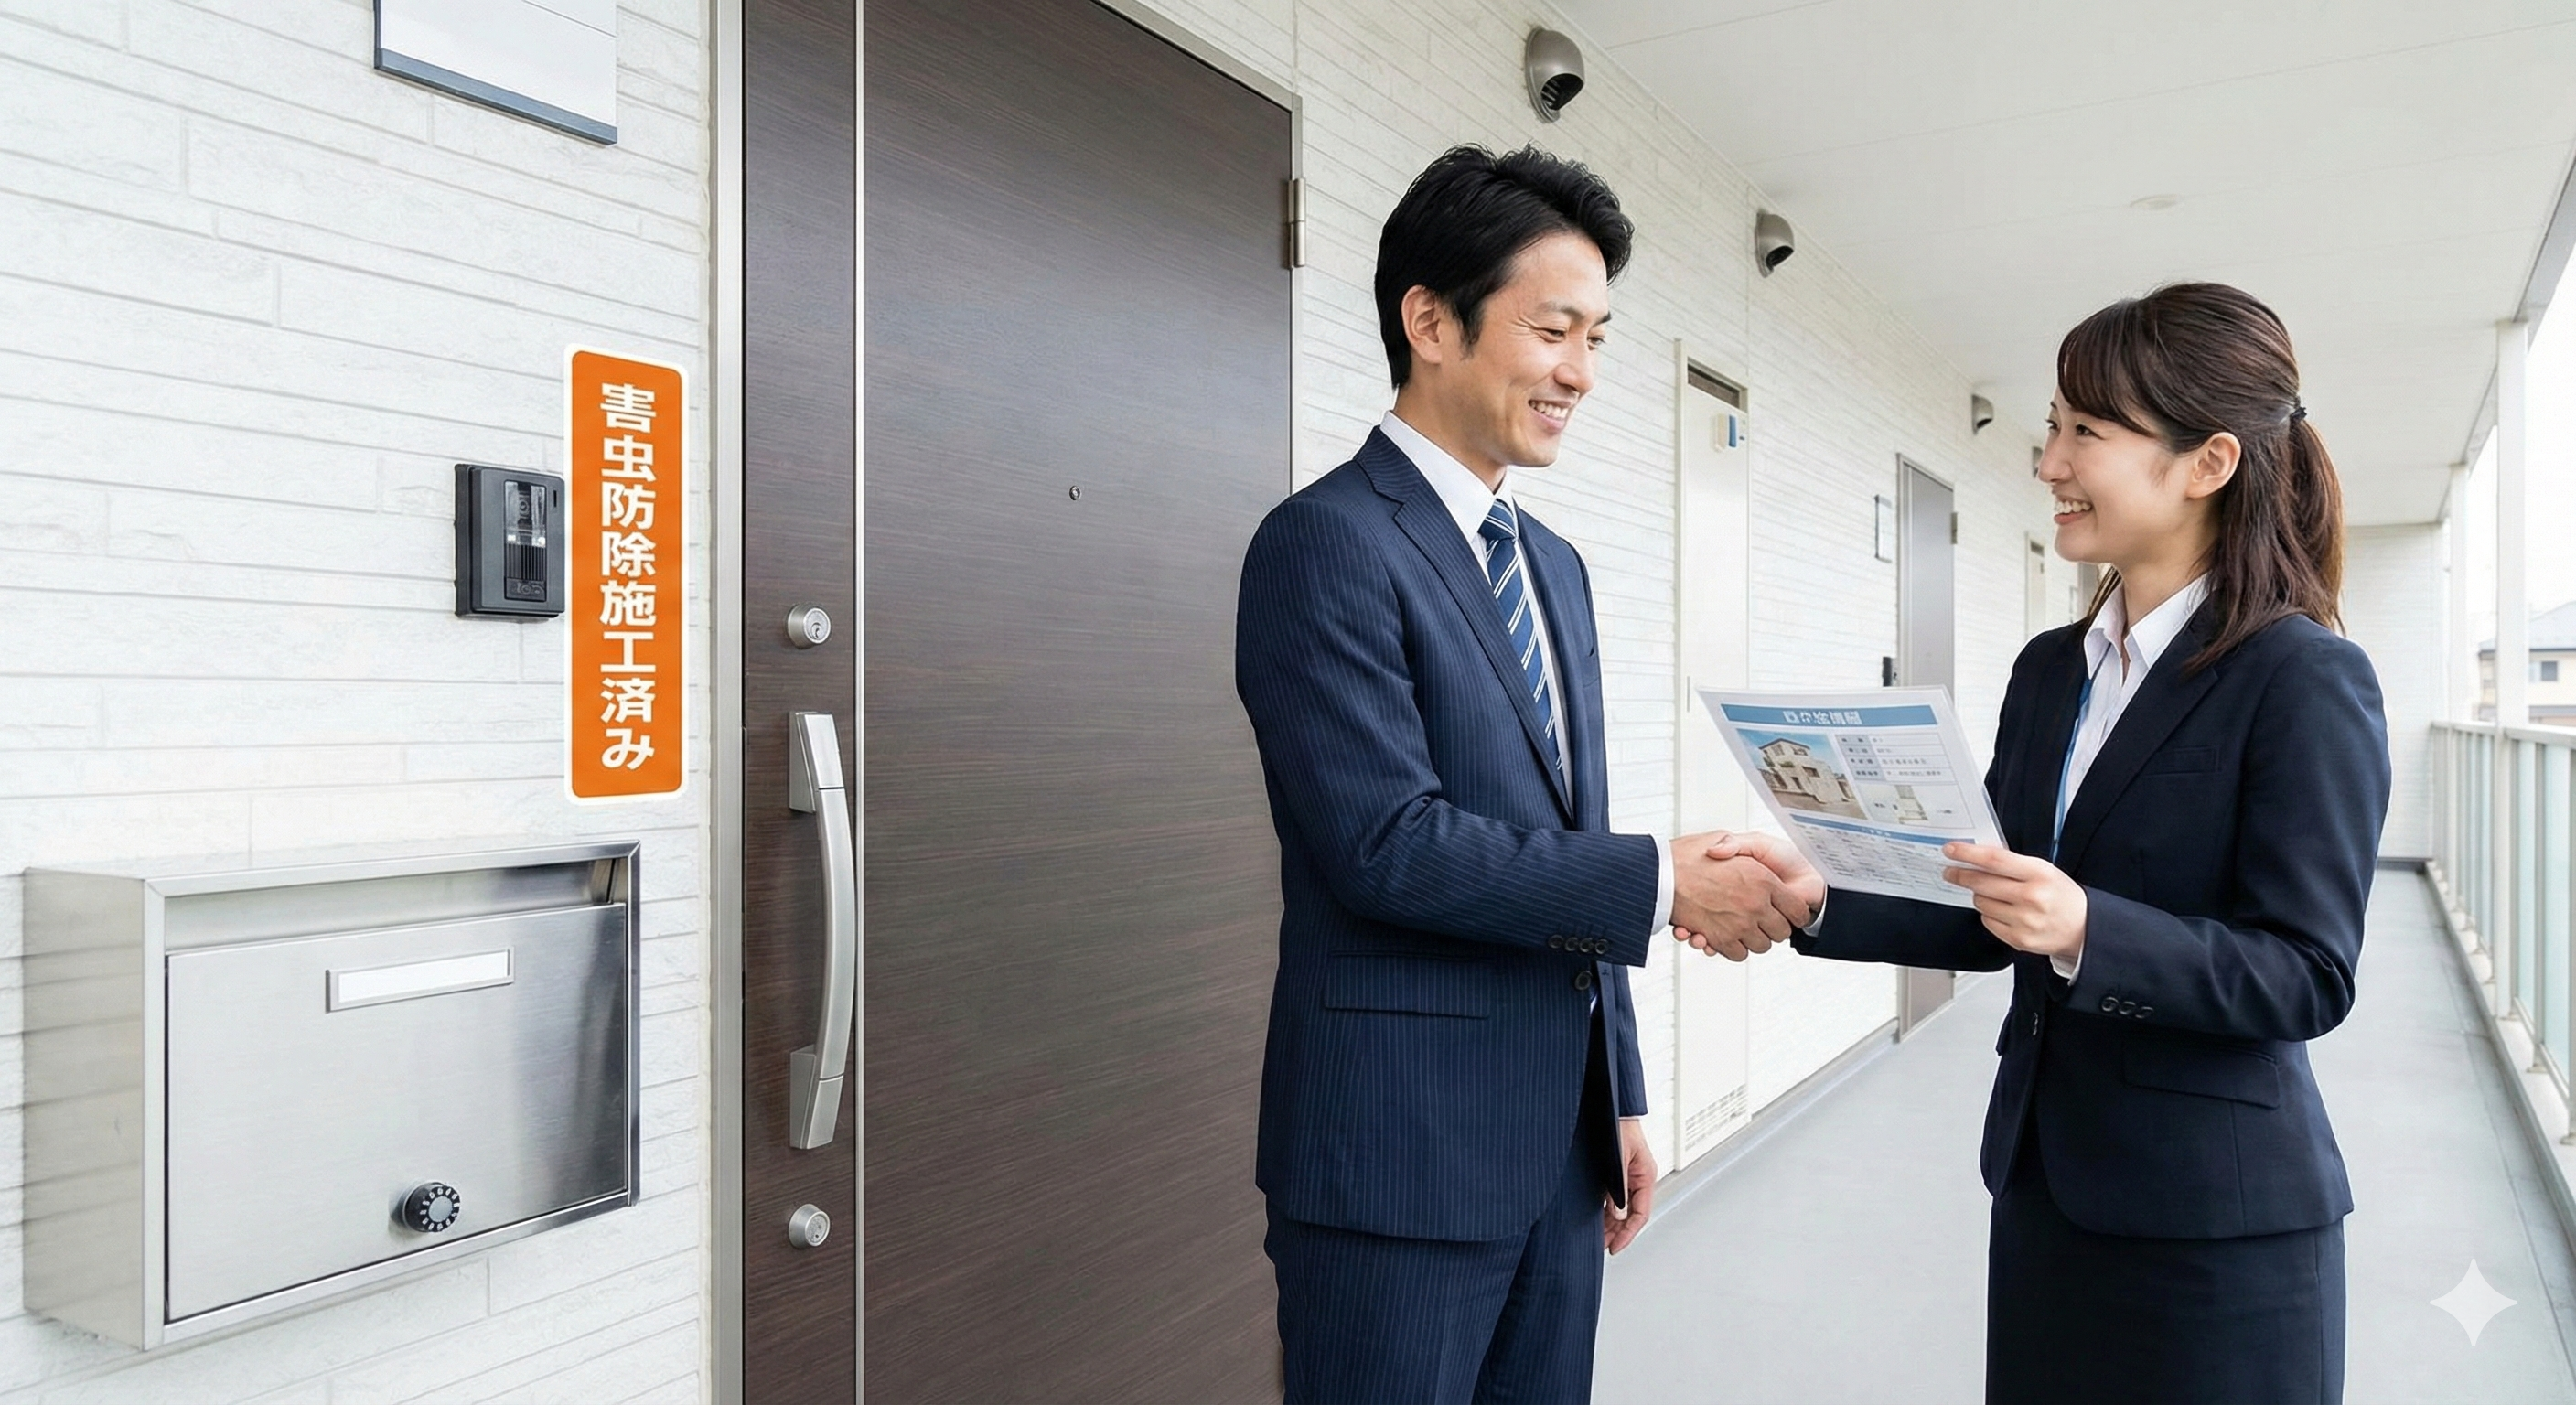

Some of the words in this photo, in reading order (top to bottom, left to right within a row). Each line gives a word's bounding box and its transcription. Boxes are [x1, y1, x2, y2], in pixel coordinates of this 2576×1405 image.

[599, 383, 657, 770] 害虫防除施工済み
